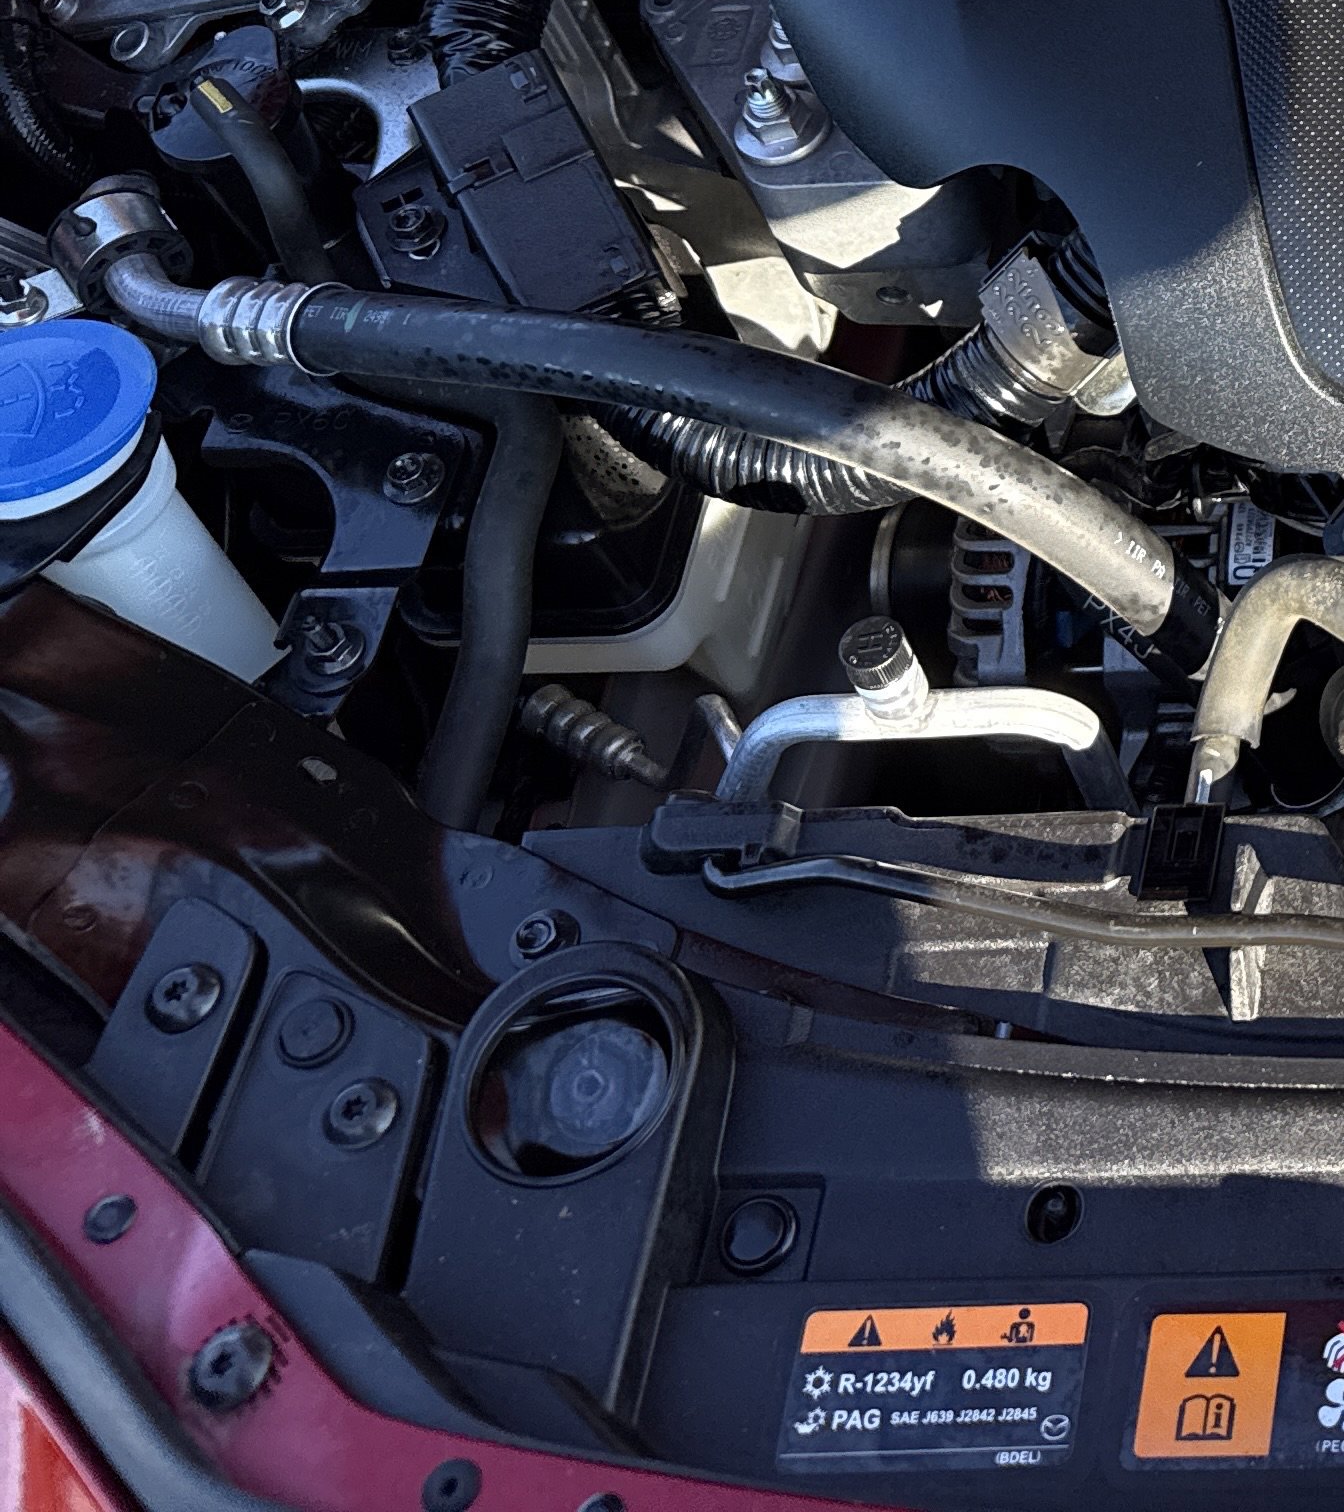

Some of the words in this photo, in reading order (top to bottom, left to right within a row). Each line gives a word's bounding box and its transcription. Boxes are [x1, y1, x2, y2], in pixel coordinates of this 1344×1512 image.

[837, 1369, 936, 1398] R-1234yf
[961, 1367, 1020, 1390] 0.480
[1024, 1367, 1052, 1393] kg
[831, 1408, 882, 1431] PAG
[890, 1410, 921, 1425] SAE
[921, 1409, 955, 1425] J639
[956, 1408, 996, 1424] J2842
[997, 1406, 1038, 1422] J2845
